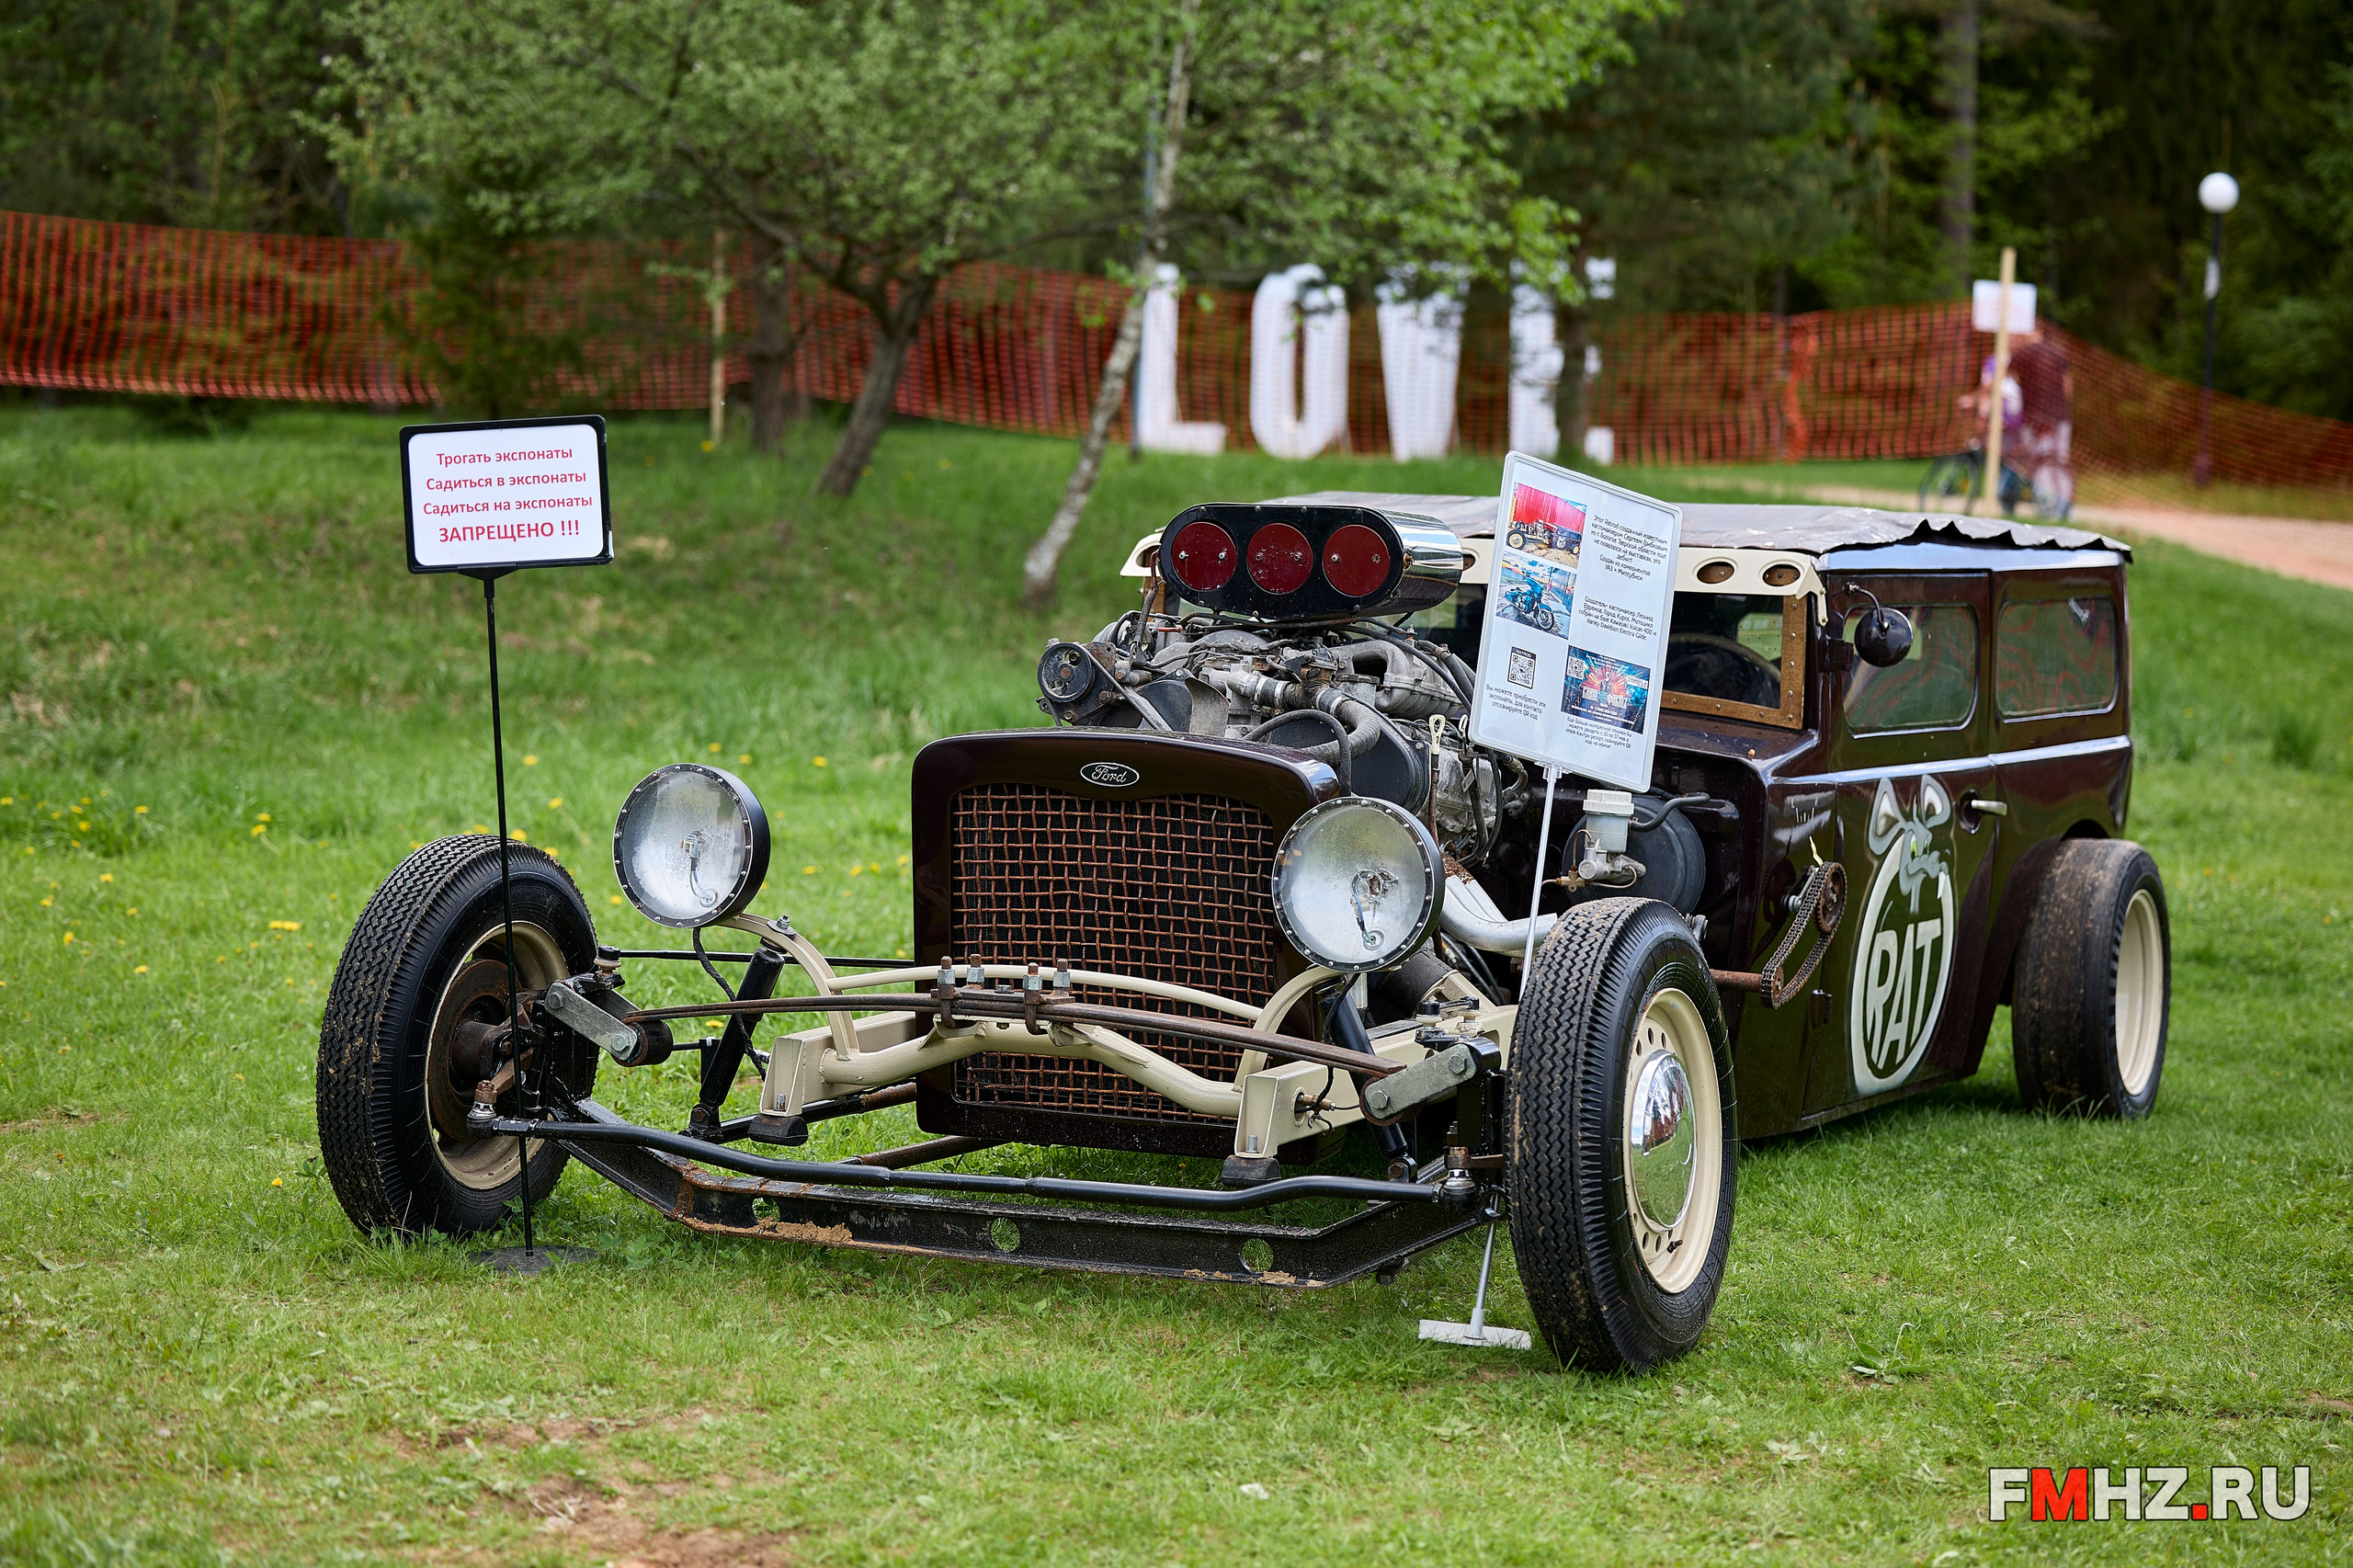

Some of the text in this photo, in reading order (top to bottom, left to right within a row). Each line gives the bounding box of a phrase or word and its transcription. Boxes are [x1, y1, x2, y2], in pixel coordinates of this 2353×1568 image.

[437, 449, 572, 467] Трогать экспонаты
[427, 473, 586, 492] Садиться в экспонаты
[423, 497, 592, 516] Садиться на экспонаты
[439, 520, 579, 542] ЗАПРЕЩЕНО !!!
[1592, 523, 1623, 538] кастомайзером
[1624, 534, 1642, 544] Сергеем
[1619, 526, 1642, 537] созданный
[1643, 534, 1667, 544] известным
[1600, 541, 1621, 552] появлялся
[1618, 539, 1636, 550] Тверской
[1638, 546, 1656, 556] области
[1600, 554, 1614, 565] Создан
[1621, 564, 1650, 576] компонентов
[1618, 569, 1643, 581] Митсубиси
[1579, 609, 1593, 617] собран
[1610, 618, 1629, 628] Kawasaki
[1630, 624, 1643, 632] Vulcan
[1609, 605, 1636, 617] кастомайзер
[1636, 612, 1653, 622] Леонид
[1586, 618, 1599, 628] Harley
[1600, 622, 1619, 632] Davidson
[1620, 628, 1635, 637] Electra
[1631, 618, 1653, 628] Мотоцикл
[1494, 688, 1512, 696] можете
[1513, 693, 1538, 704] приобрести
[1492, 702, 1522, 715] отсканируйте
[1524, 704, 1542, 714] контакта
[1092, 765, 1127, 783] Ford
[1865, 918, 1942, 1071] RAT
